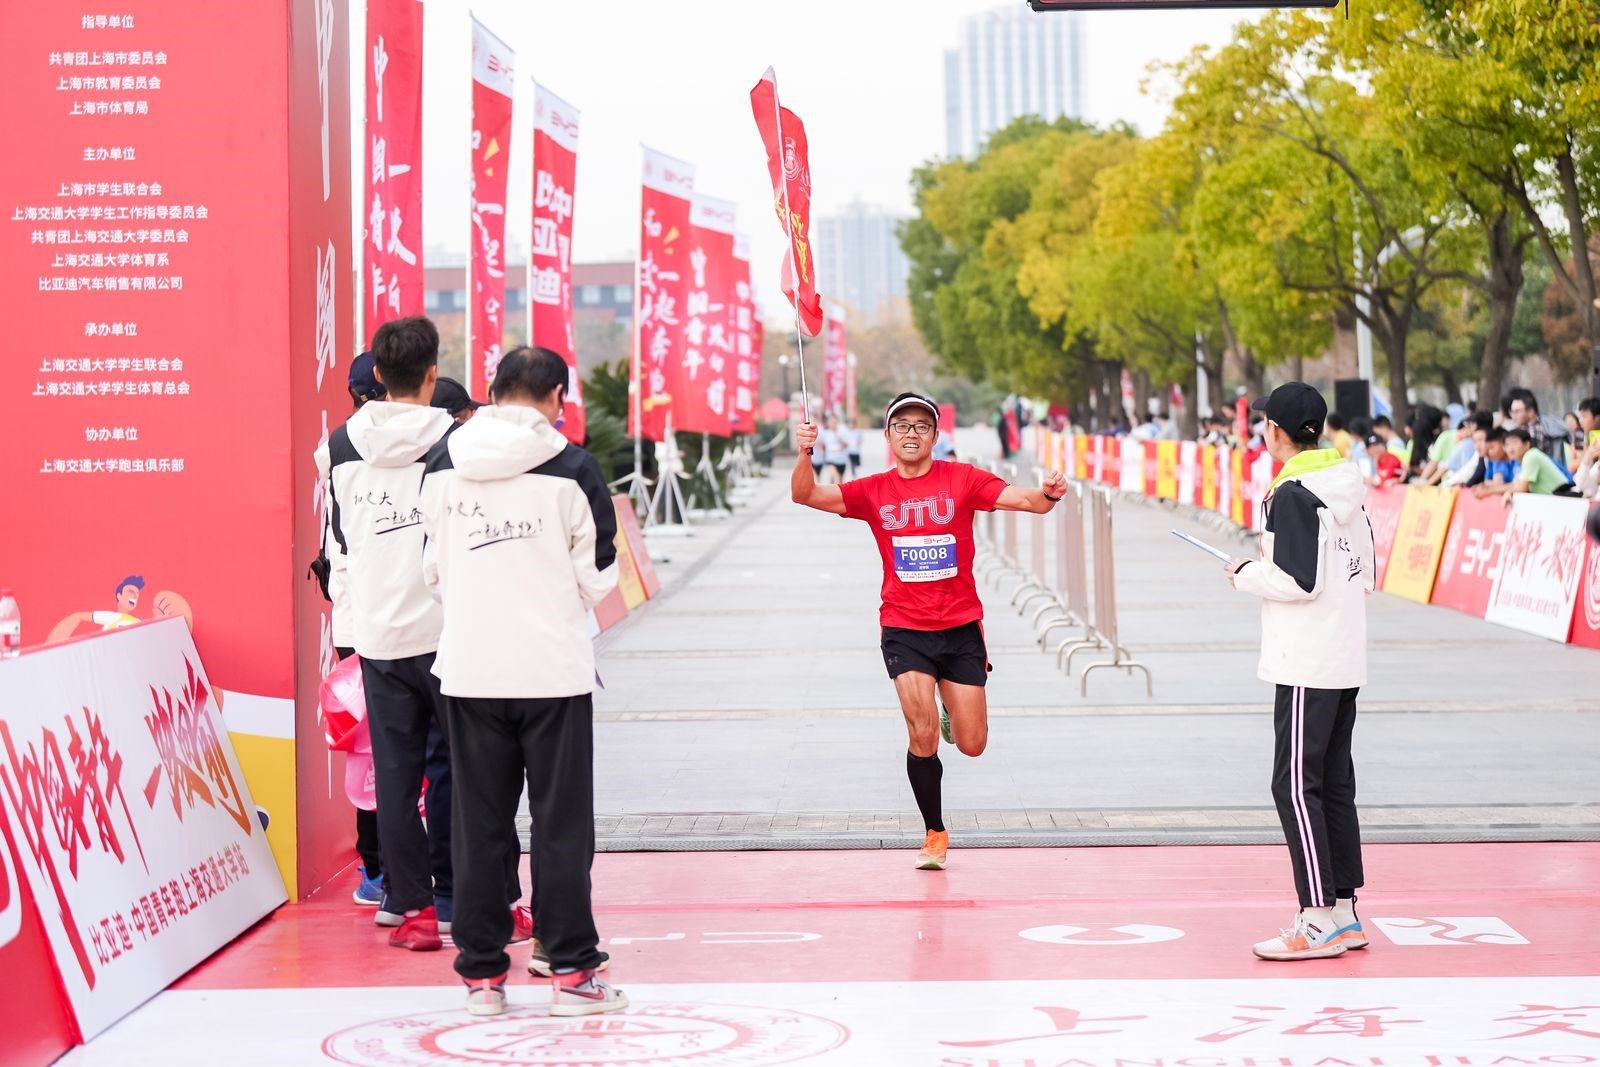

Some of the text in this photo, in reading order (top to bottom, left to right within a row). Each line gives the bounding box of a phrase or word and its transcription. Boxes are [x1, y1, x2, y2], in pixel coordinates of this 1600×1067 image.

[82, 14, 134, 29] 指导单位
[49, 51, 167, 66] 共青团上海市委员会
[56, 76, 161, 90] 上海市教育委员会
[69, 100, 148, 115] 上海市体育局
[83, 146, 136, 161] 主办单位
[57, 182, 162, 196] 上海市学生联合会
[11, 205, 208, 221] 上海交通大学学生工作指导委员会
[31, 229, 188, 244] 共青团上海交通大学委员会
[51, 253, 169, 267] 上海交通大学体育系
[39, 276, 182, 291] 比亚迪汽车销售有限公司
[85, 322, 137, 336] 承办单位
[39, 357, 183, 372] 上海交通大学学生联合会
[32, 381, 190, 396] 上海交通大学学生体育总会
[85, 427, 138, 441] 协办单位
[40, 458, 184, 473] 上海交通大学跑虫俱乐部
[879, 498, 955, 531] SJTU
[901, 547, 948, 562] F0008
